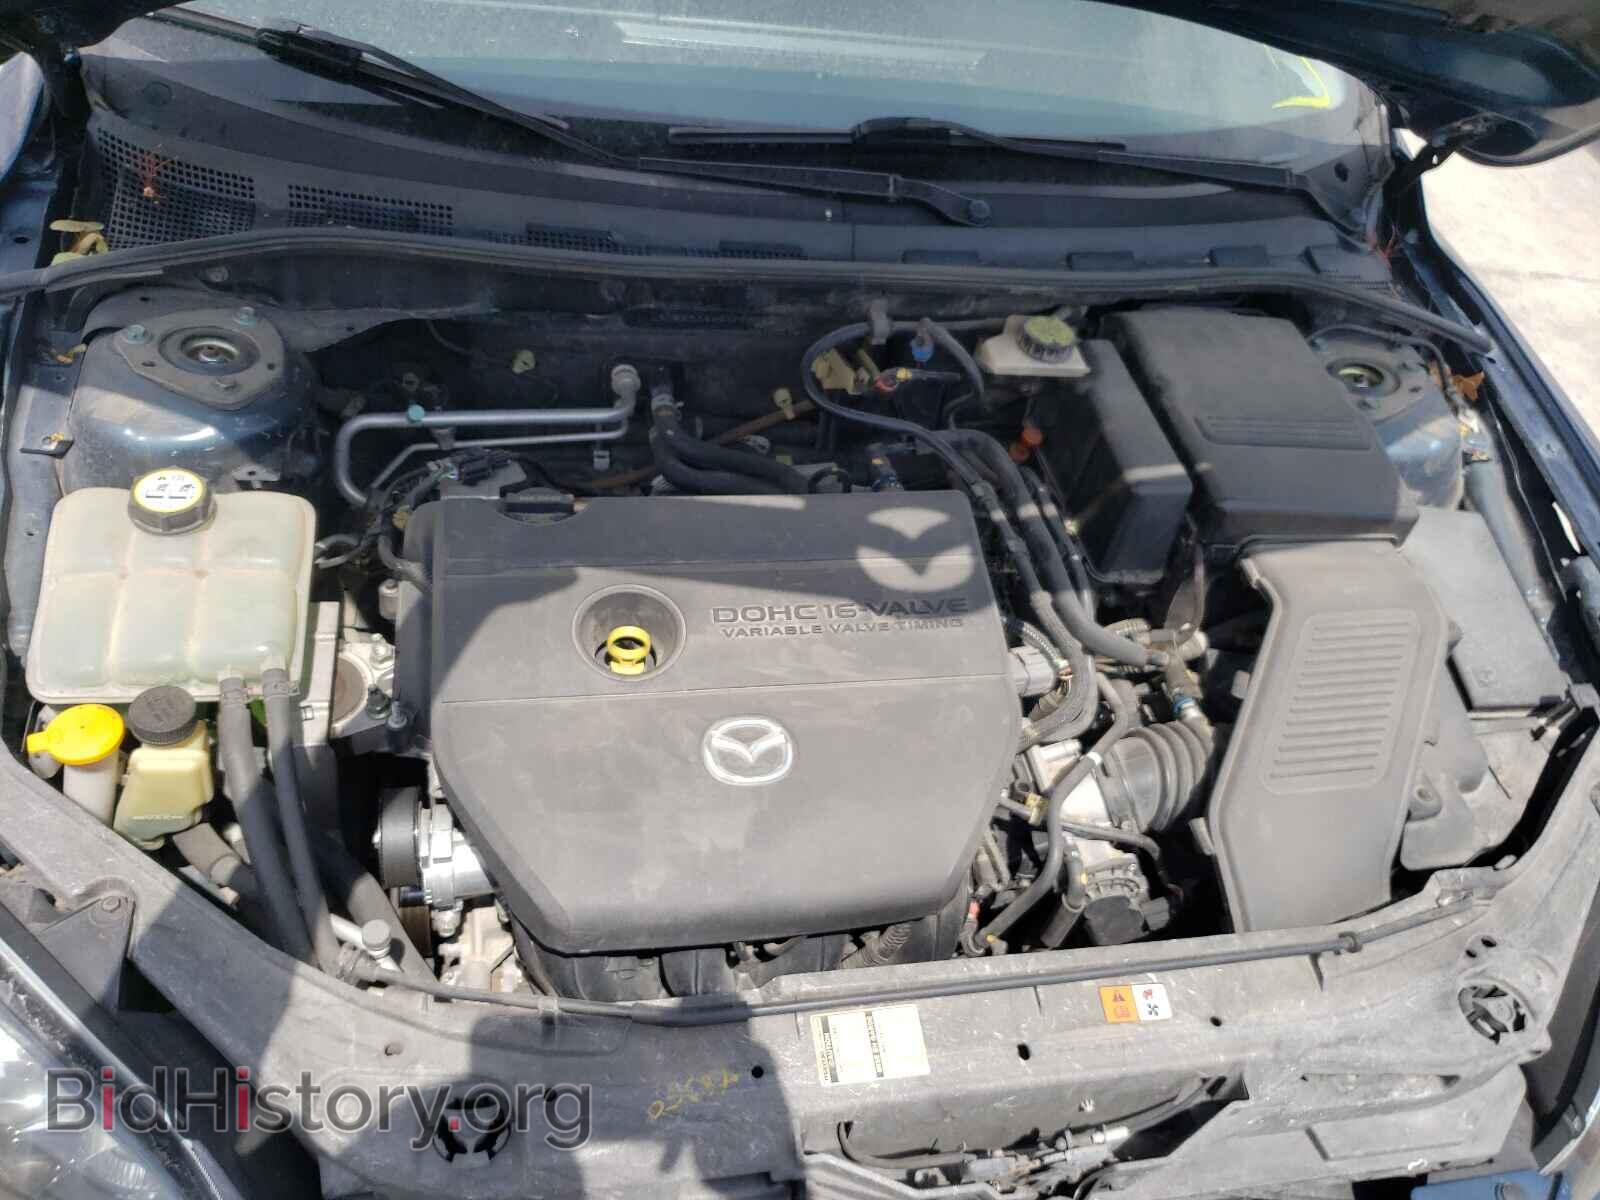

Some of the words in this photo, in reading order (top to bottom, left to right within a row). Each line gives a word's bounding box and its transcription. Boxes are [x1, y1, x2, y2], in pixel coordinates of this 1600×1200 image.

[712, 604, 818, 624] DOHC
[721, 624, 824, 638] VARIABLE
[829, 620, 890, 634] VALVE
[896, 617, 965, 631] TIMING
